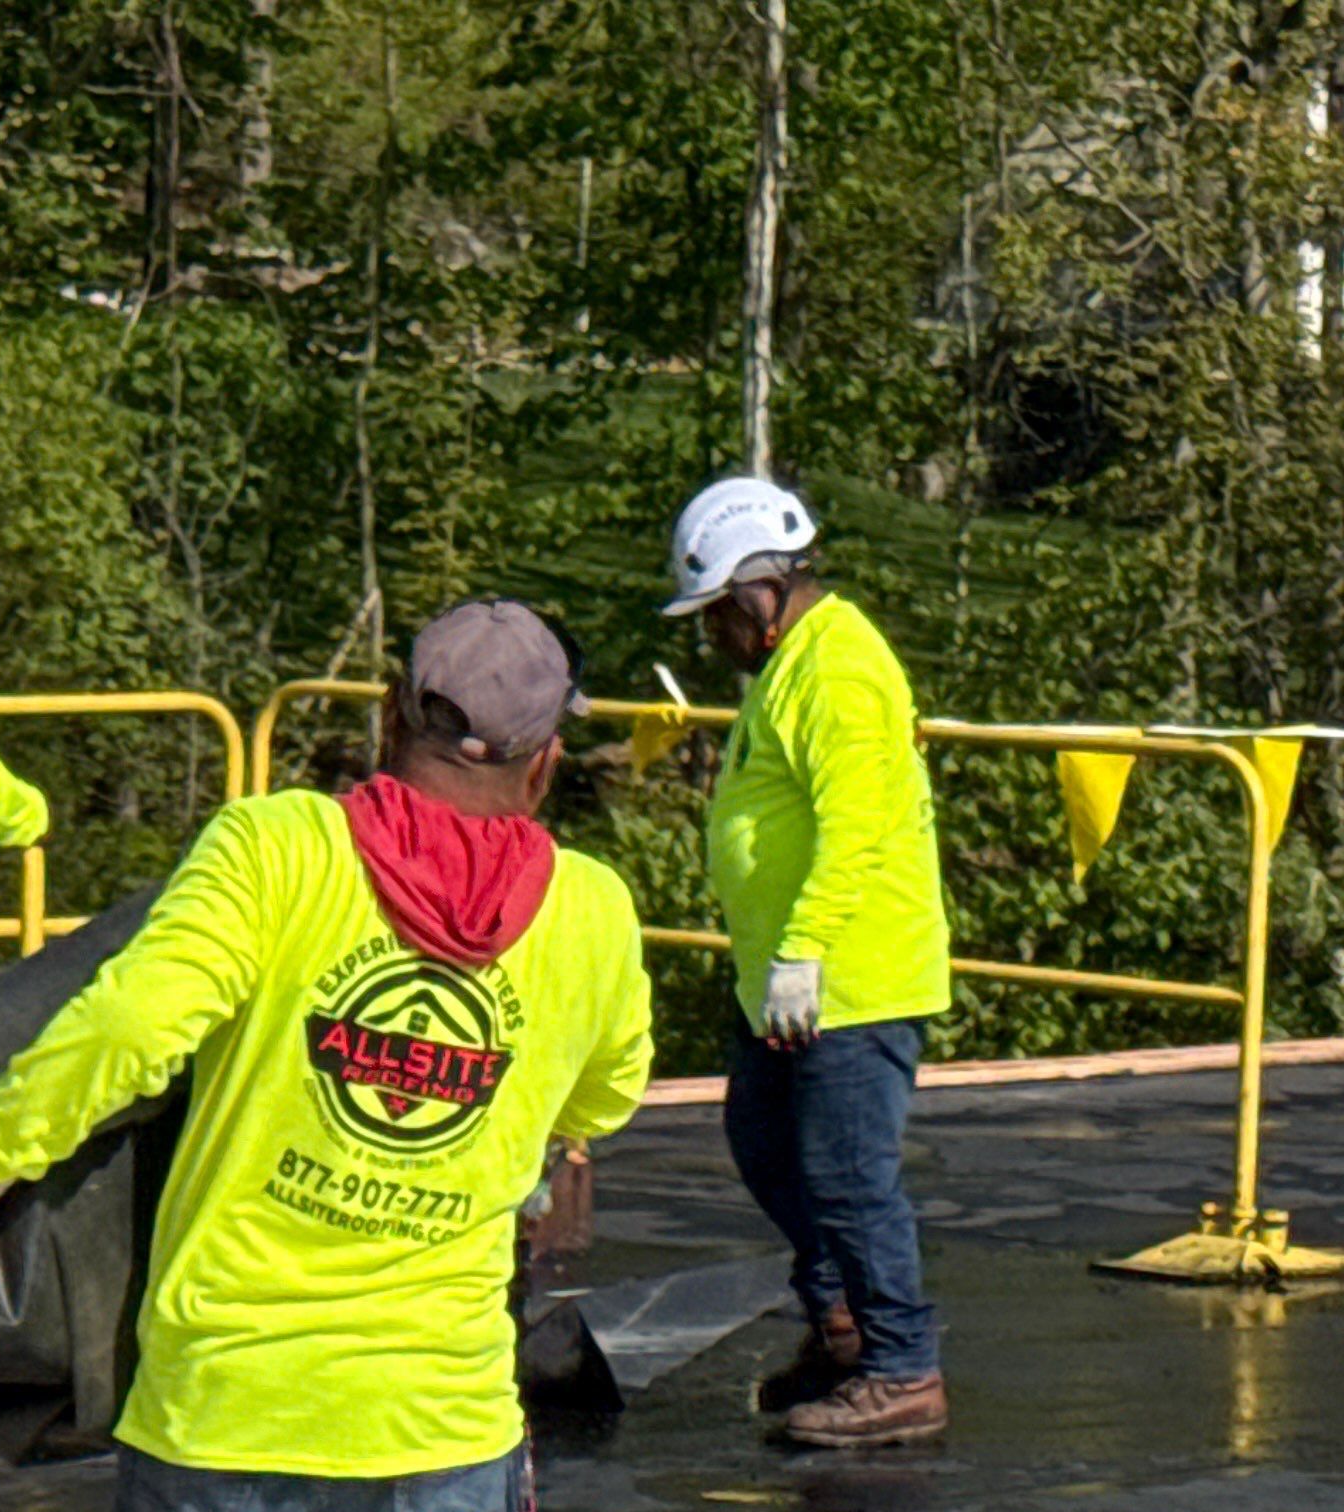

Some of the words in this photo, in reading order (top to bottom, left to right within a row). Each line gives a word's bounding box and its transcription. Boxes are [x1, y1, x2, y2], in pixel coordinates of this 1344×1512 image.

[314, 932, 397, 998] EXPERI
[485, 959, 525, 1032] TTERS
[318, 1020, 502, 1087] ALLSITE
[262, 1179, 464, 1247] ALLSITEROOFING.CO
[276, 1146, 473, 1224] 877-907-7771
